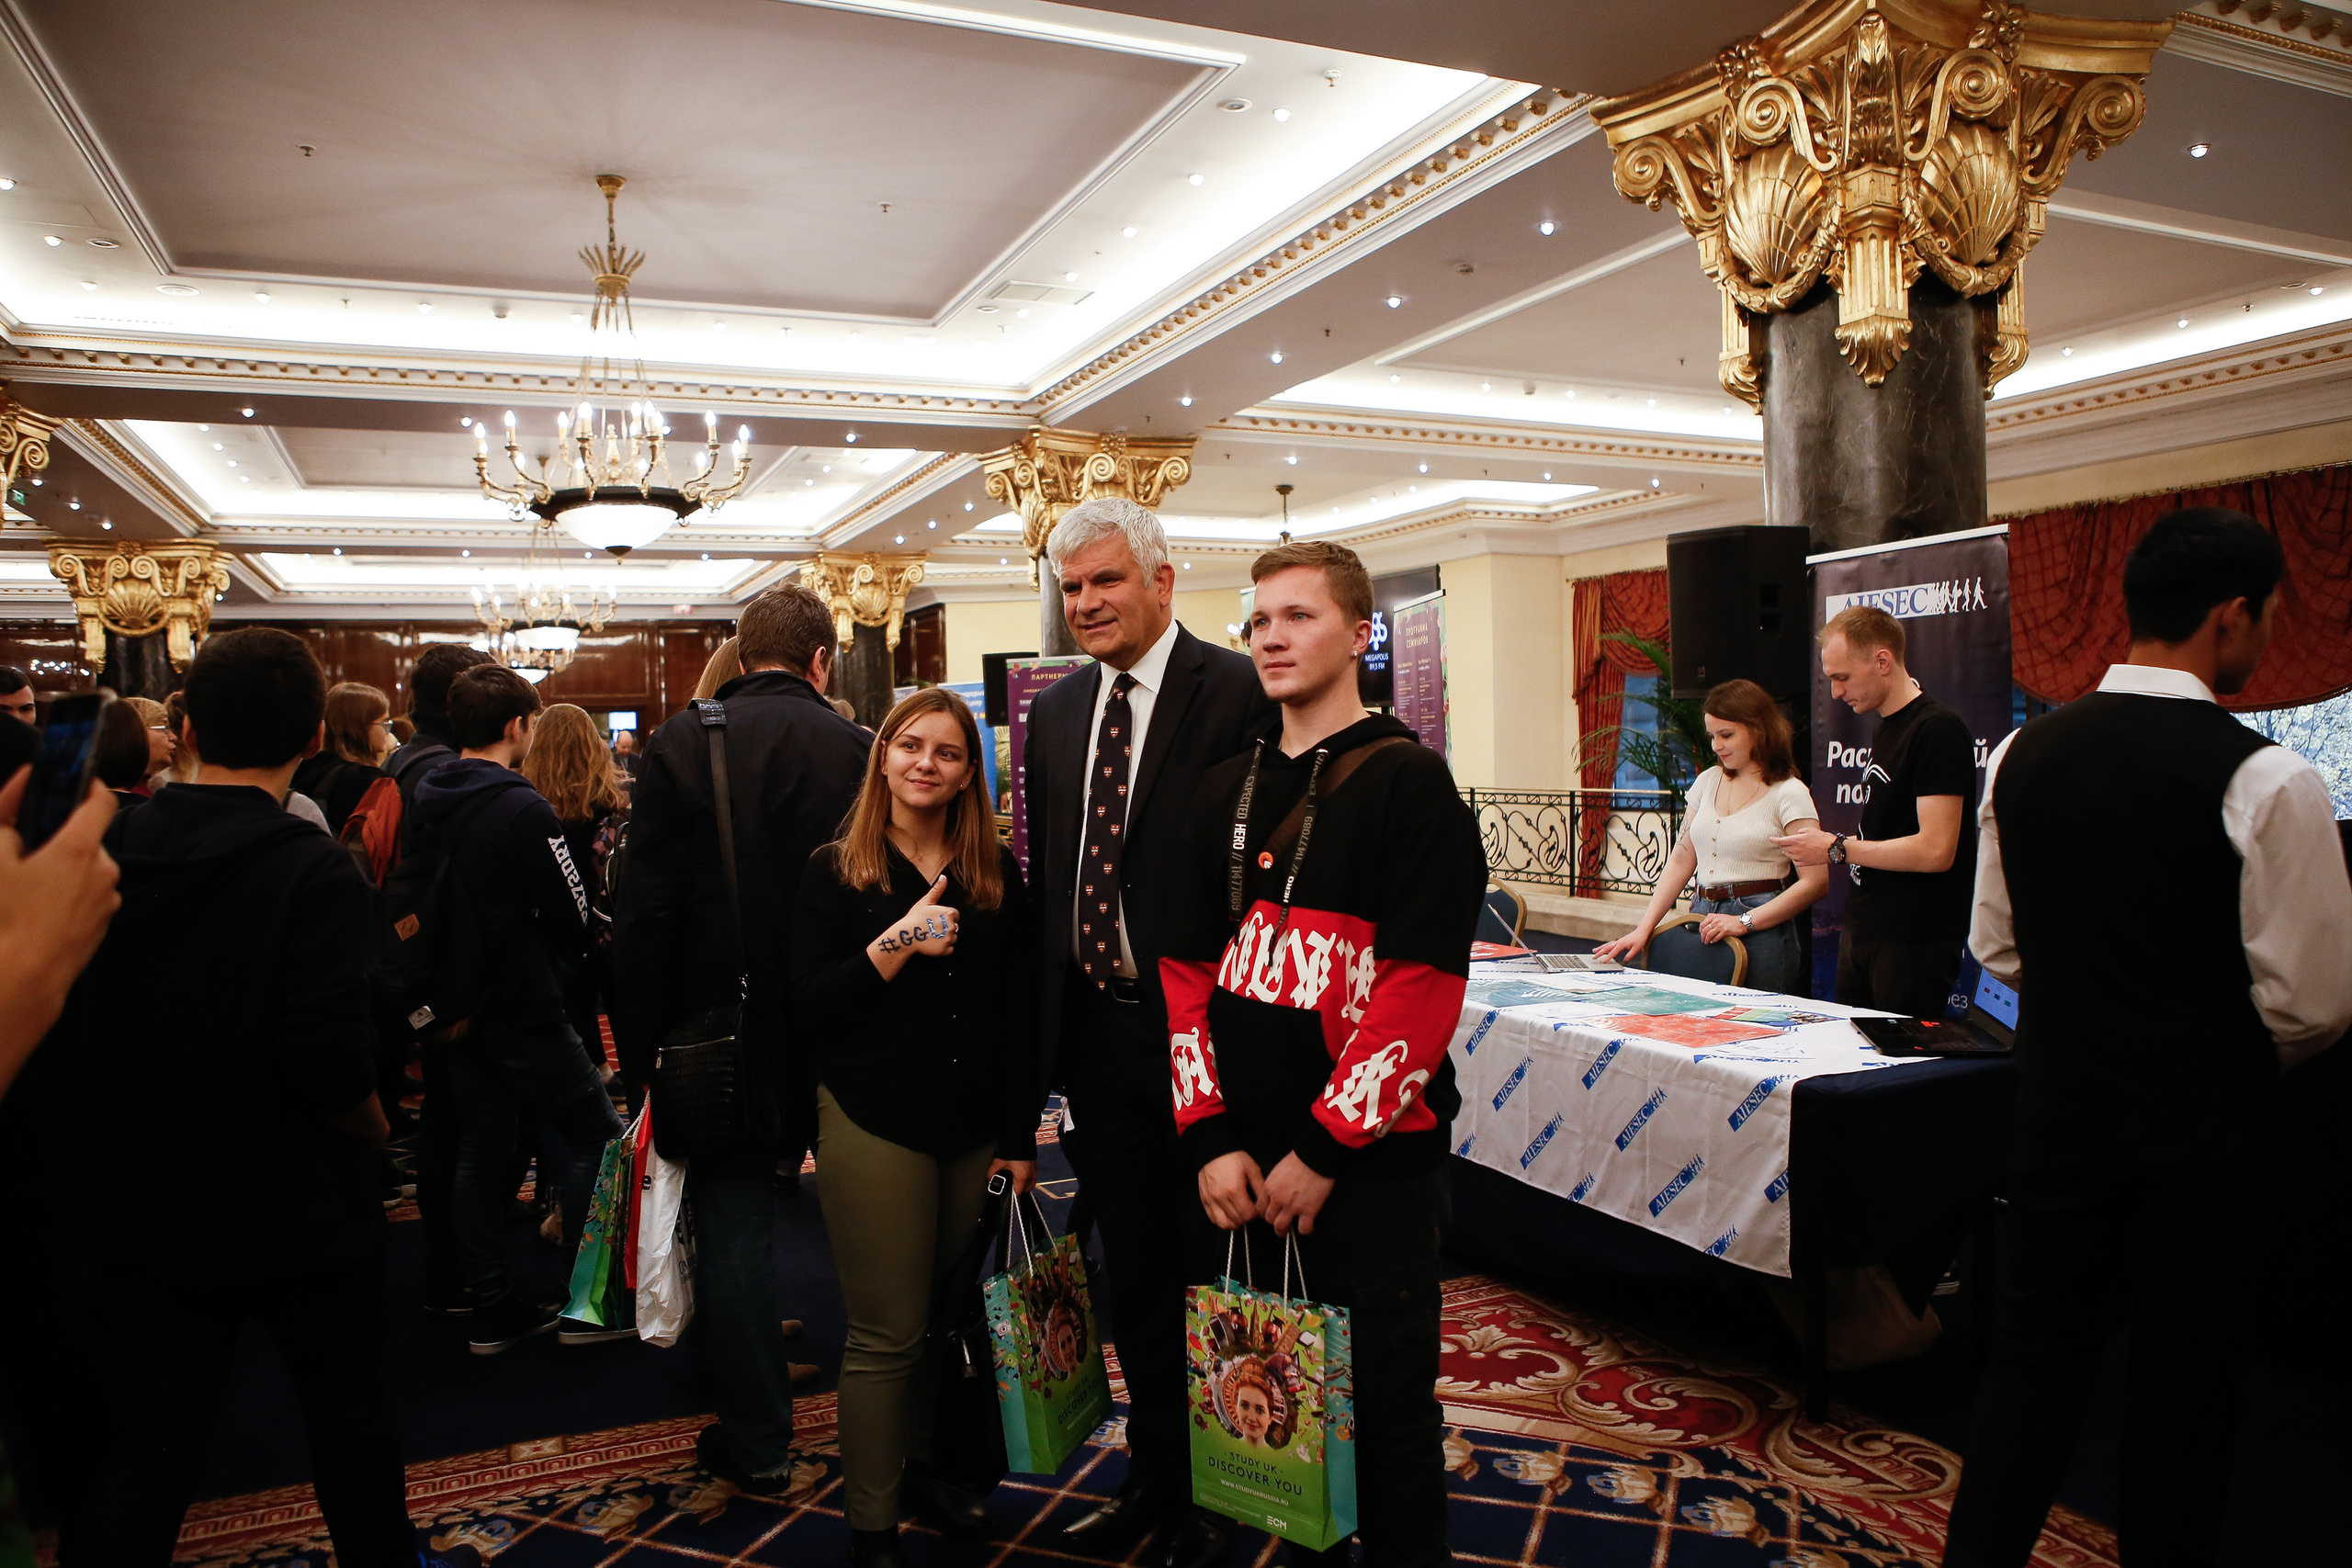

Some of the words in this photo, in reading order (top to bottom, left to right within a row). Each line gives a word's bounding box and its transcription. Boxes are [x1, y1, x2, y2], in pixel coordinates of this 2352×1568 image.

[1364, 653, 1389, 661] MEGAPOLIS
[1237, 775, 1255, 819] EXPECTED
[1232, 823, 1247, 851] HERO
[1283, 875, 1295, 903] HERO
[877, 914, 949, 953] #GGU
[1469, 1012, 1493, 1050] AIESEC
[1589, 1043, 1615, 1085] AIESEC
[1497, 1069, 1521, 1106] AIESEC
[1735, 1081, 1770, 1126] AIESEC
[1621, 1105, 1650, 1146] AIESEC
[1523, 1128, 1550, 1165] AIESEC
[1655, 1172, 1689, 1213] AIESEC
[1057, 1389, 1089, 1425] DISCOVER
[1208, 1456, 1270, 1486] DISCOVER
[1274, 1478, 1303, 1495] YOU
[1230, 1451, 1260, 1468] STUDY
[1263, 1462, 1277, 1473] UK
[1267, 1515, 1287, 1530] ECM
